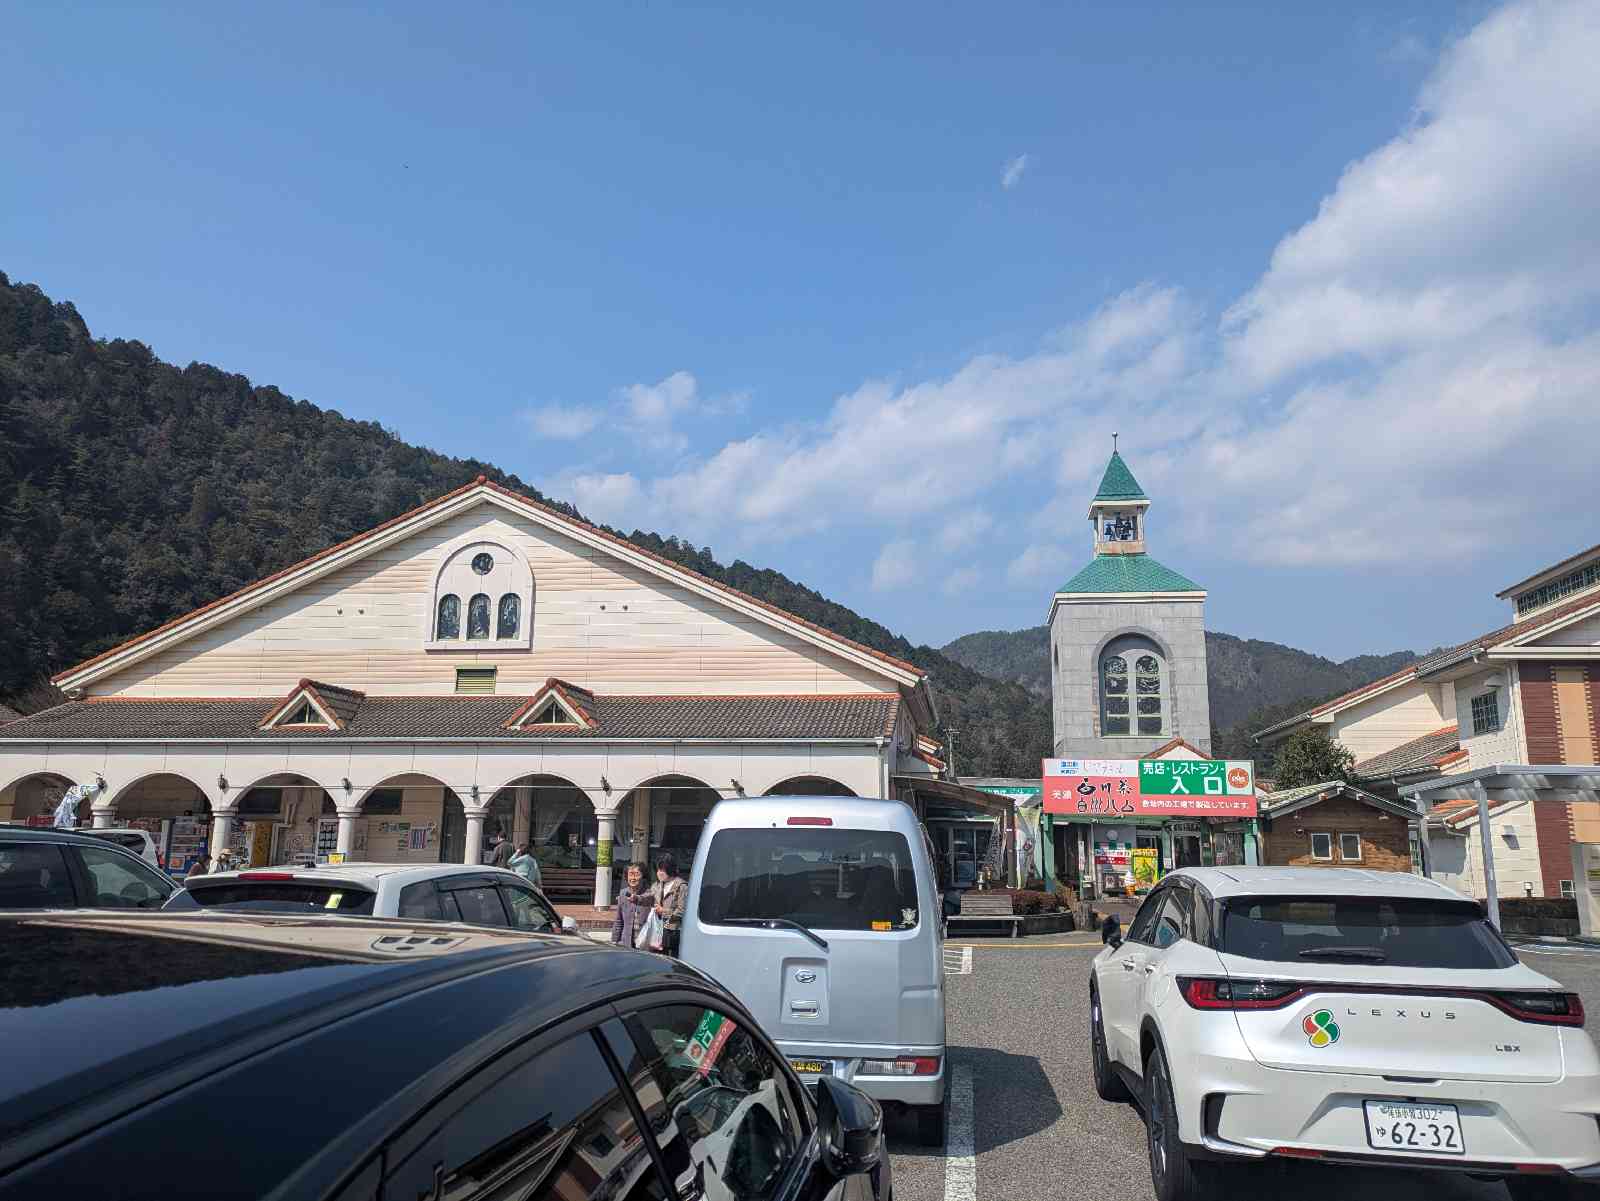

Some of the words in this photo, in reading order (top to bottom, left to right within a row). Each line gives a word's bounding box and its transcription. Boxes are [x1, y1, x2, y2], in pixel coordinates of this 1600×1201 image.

[1170, 776, 1223, 795] 入口
[1347, 1007, 1456, 1020] LEXUS
[1495, 1044, 1521, 1053] LBX
[1376, 1126, 1387, 1138] ゆ
[1391, 1121, 1458, 1148] 62-32
